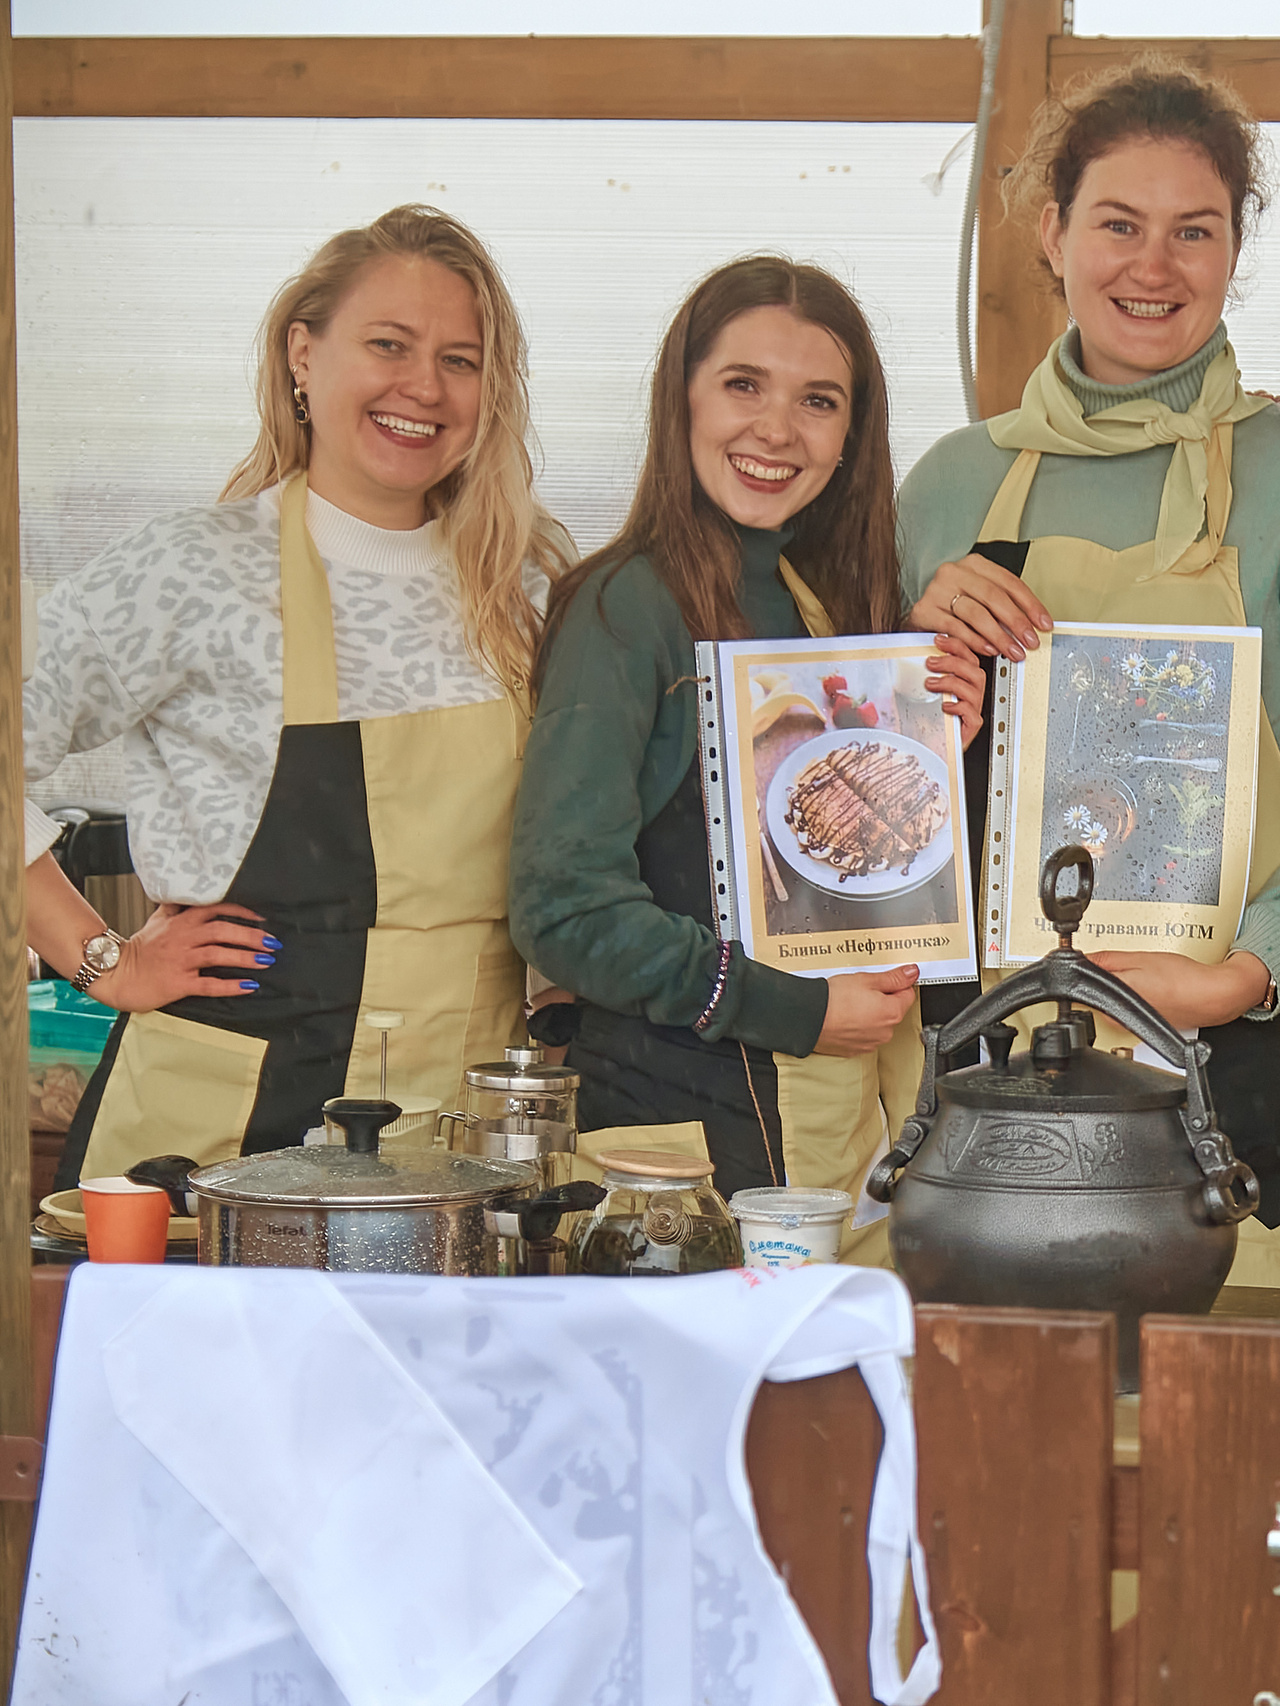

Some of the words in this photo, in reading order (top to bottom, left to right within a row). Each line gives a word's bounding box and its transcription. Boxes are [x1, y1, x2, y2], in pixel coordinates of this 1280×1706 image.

[1086, 922, 1158, 937] травами
[1165, 923, 1215, 940] ЮТМ
[778, 943, 832, 958] Блины
[836, 935, 951, 955] «Нефтяночка»
[265, 1223, 307, 1236] Tefal
[749, 1240, 811, 1258] Сметана
